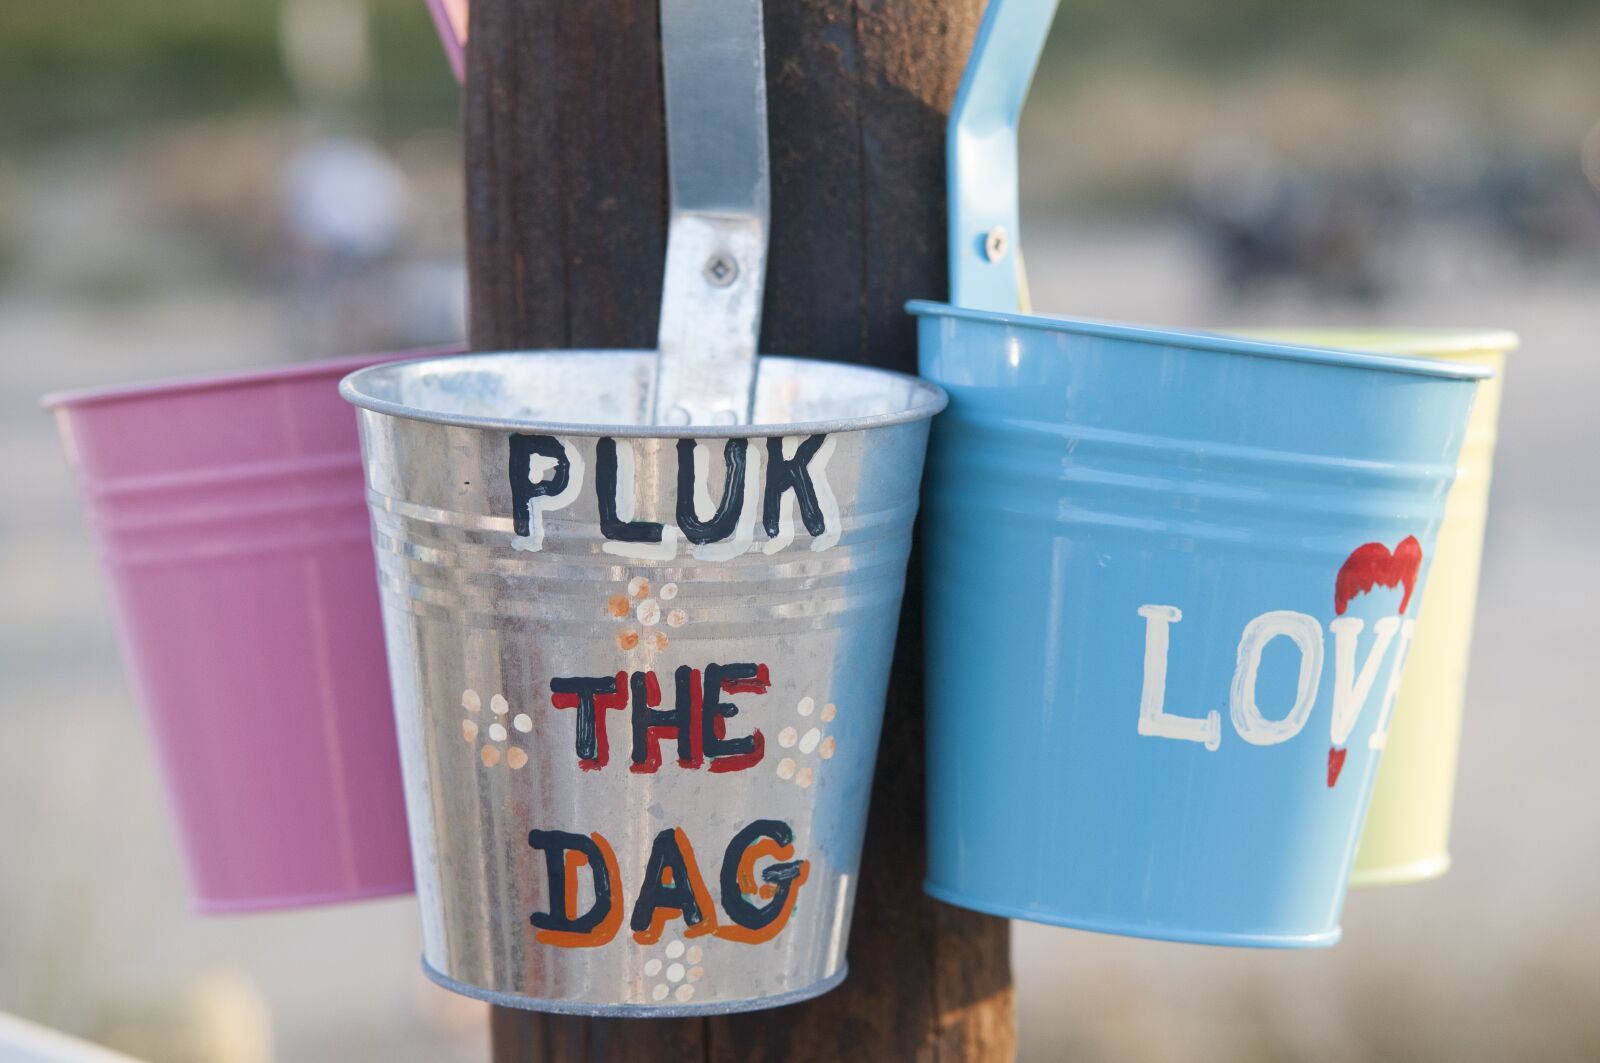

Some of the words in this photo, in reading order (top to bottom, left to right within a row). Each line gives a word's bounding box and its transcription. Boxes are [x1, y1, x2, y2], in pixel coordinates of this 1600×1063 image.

[509, 433, 841, 562] PLUK
[550, 663, 771, 774] THE
[528, 818, 810, 948] DAG
